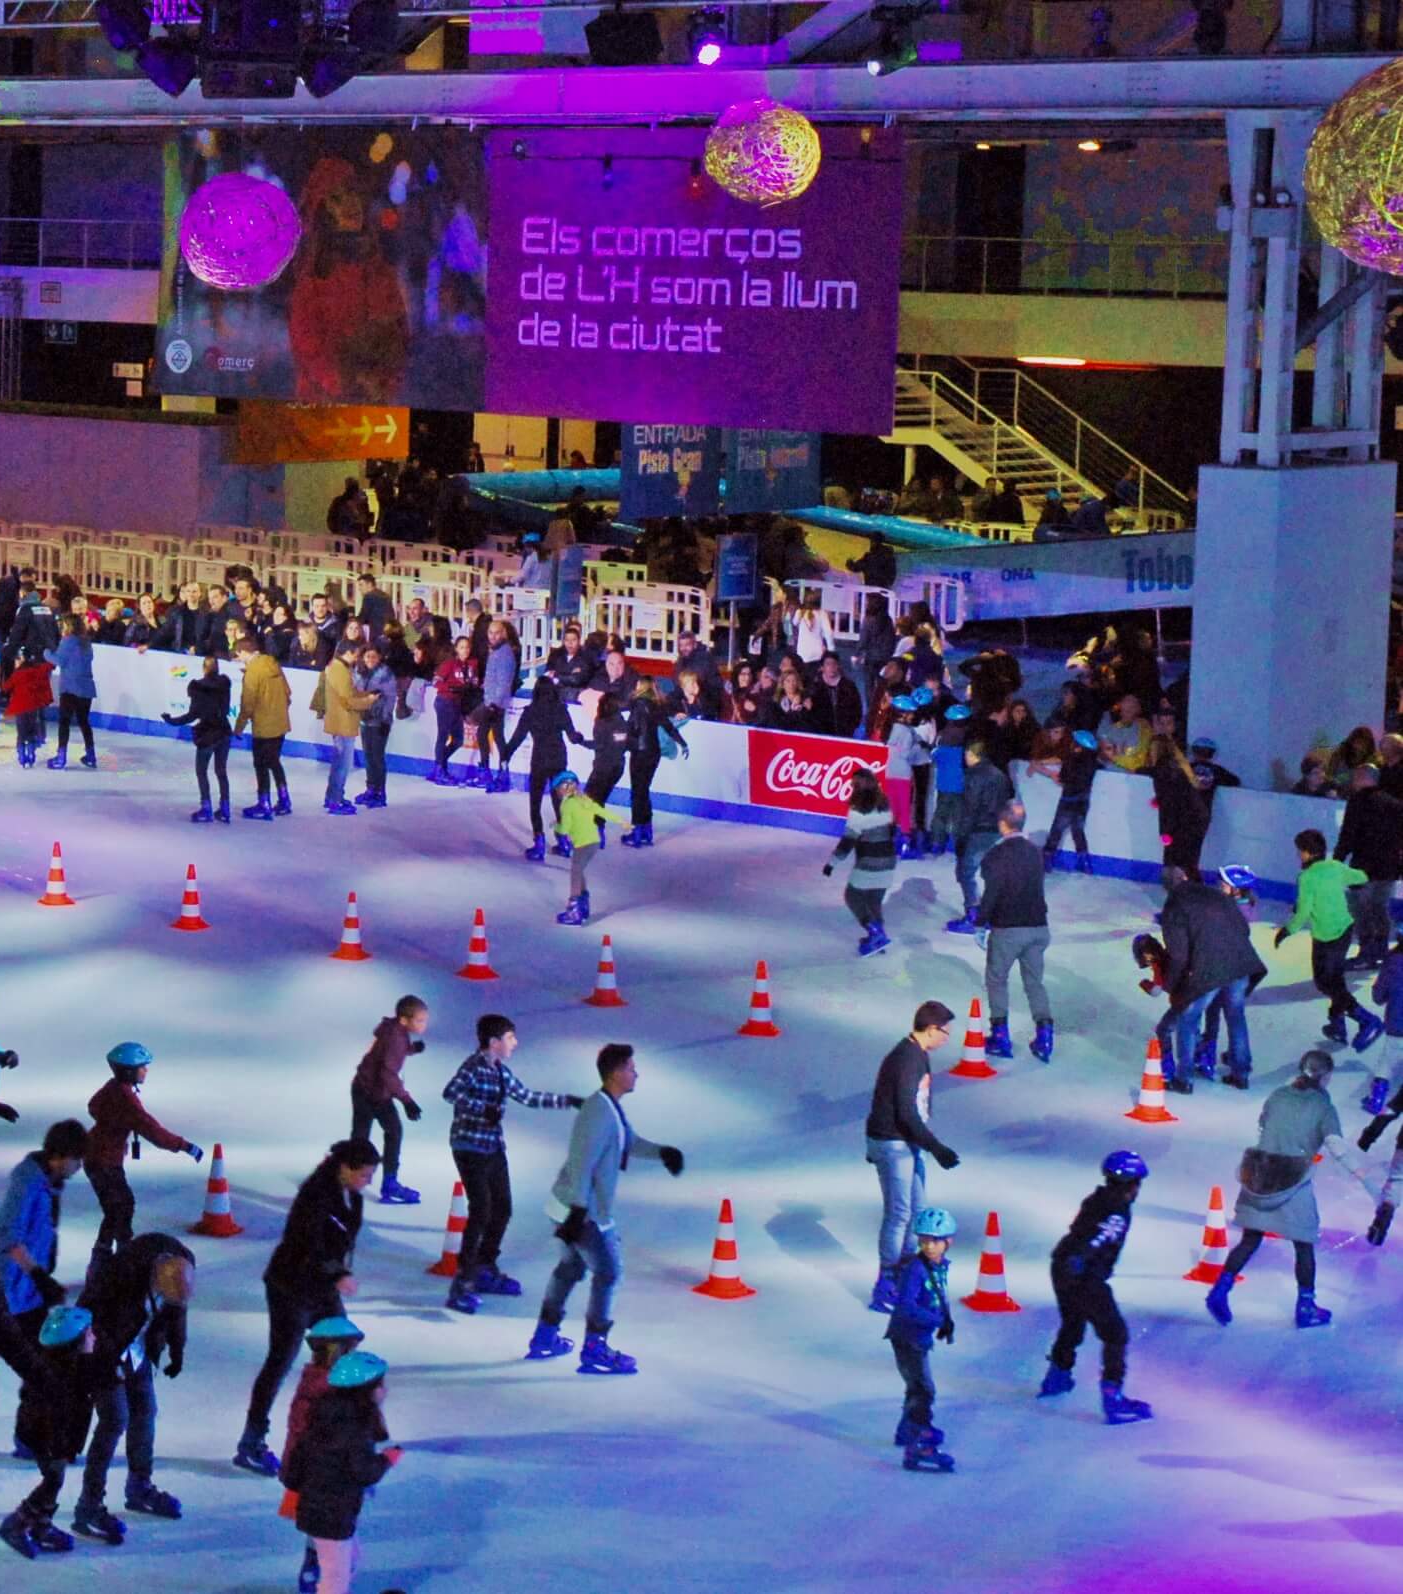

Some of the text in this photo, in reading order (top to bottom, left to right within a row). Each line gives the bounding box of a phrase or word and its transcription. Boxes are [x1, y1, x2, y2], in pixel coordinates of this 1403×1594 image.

[521, 216, 803, 264] Els comerços
[519, 264, 857, 310] de L'H som la llum
[517, 312, 723, 353] de la ciutat
[633, 424, 707, 445] ENTRADA
[766, 748, 886, 802] Coca-Co
